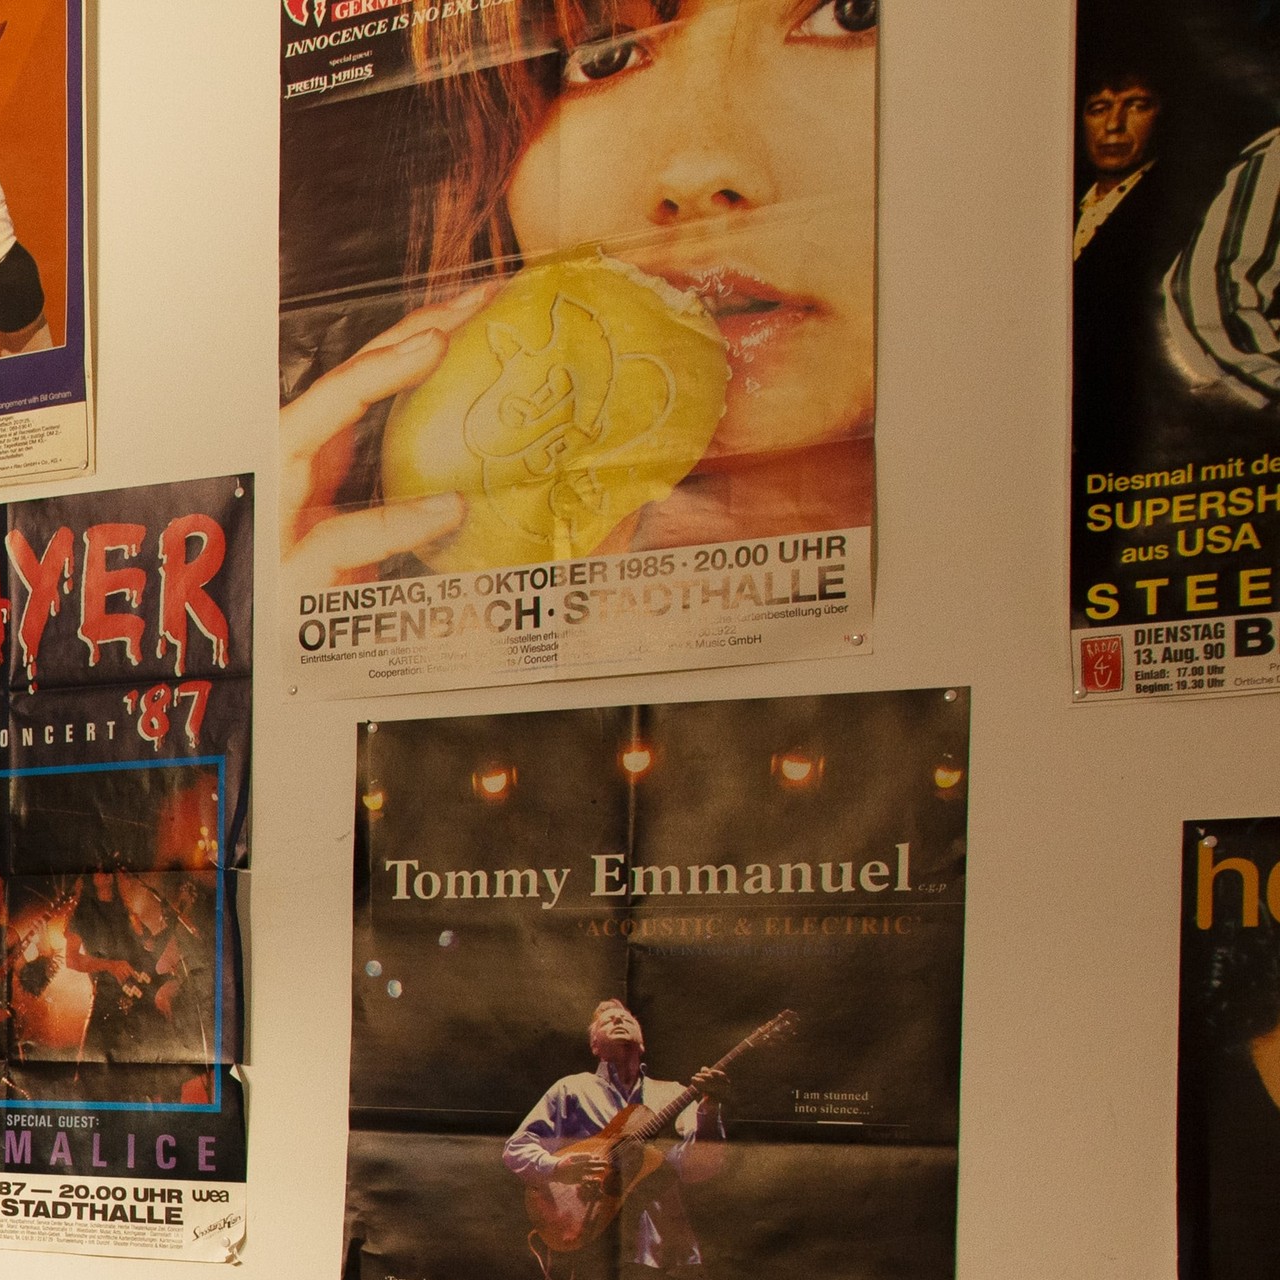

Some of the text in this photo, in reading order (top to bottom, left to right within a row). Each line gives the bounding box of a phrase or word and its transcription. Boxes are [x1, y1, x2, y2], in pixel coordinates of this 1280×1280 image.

[285, 18, 388, 58] INNOCENCE
[411, 6, 439, 27] NO
[1086, 458, 1245, 494] Diesmal mit
[1086, 484, 1280, 532] SUPERSH
[1120, 522, 1261, 564] aus USA
[299, 535, 847, 616] DIENSTAG, 15. OKTOBER 1985 20.00 UHR
[1086, 567, 1273, 620] STEE
[298, 564, 846, 651] OFFENBACH STADTHALLE
[823, 603, 849, 616] über
[728, 634, 762, 646] GmbH
[1134, 622, 1225, 646] DIENSTAG
[300, 651, 358, 665] Eintrittskarten
[1086, 639, 1119, 660] RADIO
[1134, 642, 1225, 668] 13. Aug. 90
[1134, 664, 1225, 681] Einlaß: 17.00 Uhr
[1135, 677, 1225, 694] Beginn: 19.30 Uhr
[123, 680, 212, 751] '87
[385, 842, 913, 910] Tommy Emmanuel
[794, 1103, 817, 1113] into
[823, 1091, 869, 1101] stunned
[7, 1114, 100, 1128] SPECIAL GUEST:
[5, 1130, 216, 1171] MALICE
[59, 1184, 127, 1200] 20.00
[133, 1188, 183, 1204] UHR
[192, 1189, 229, 1203] wea
[1, 1198, 184, 1225] STADTHALLE
